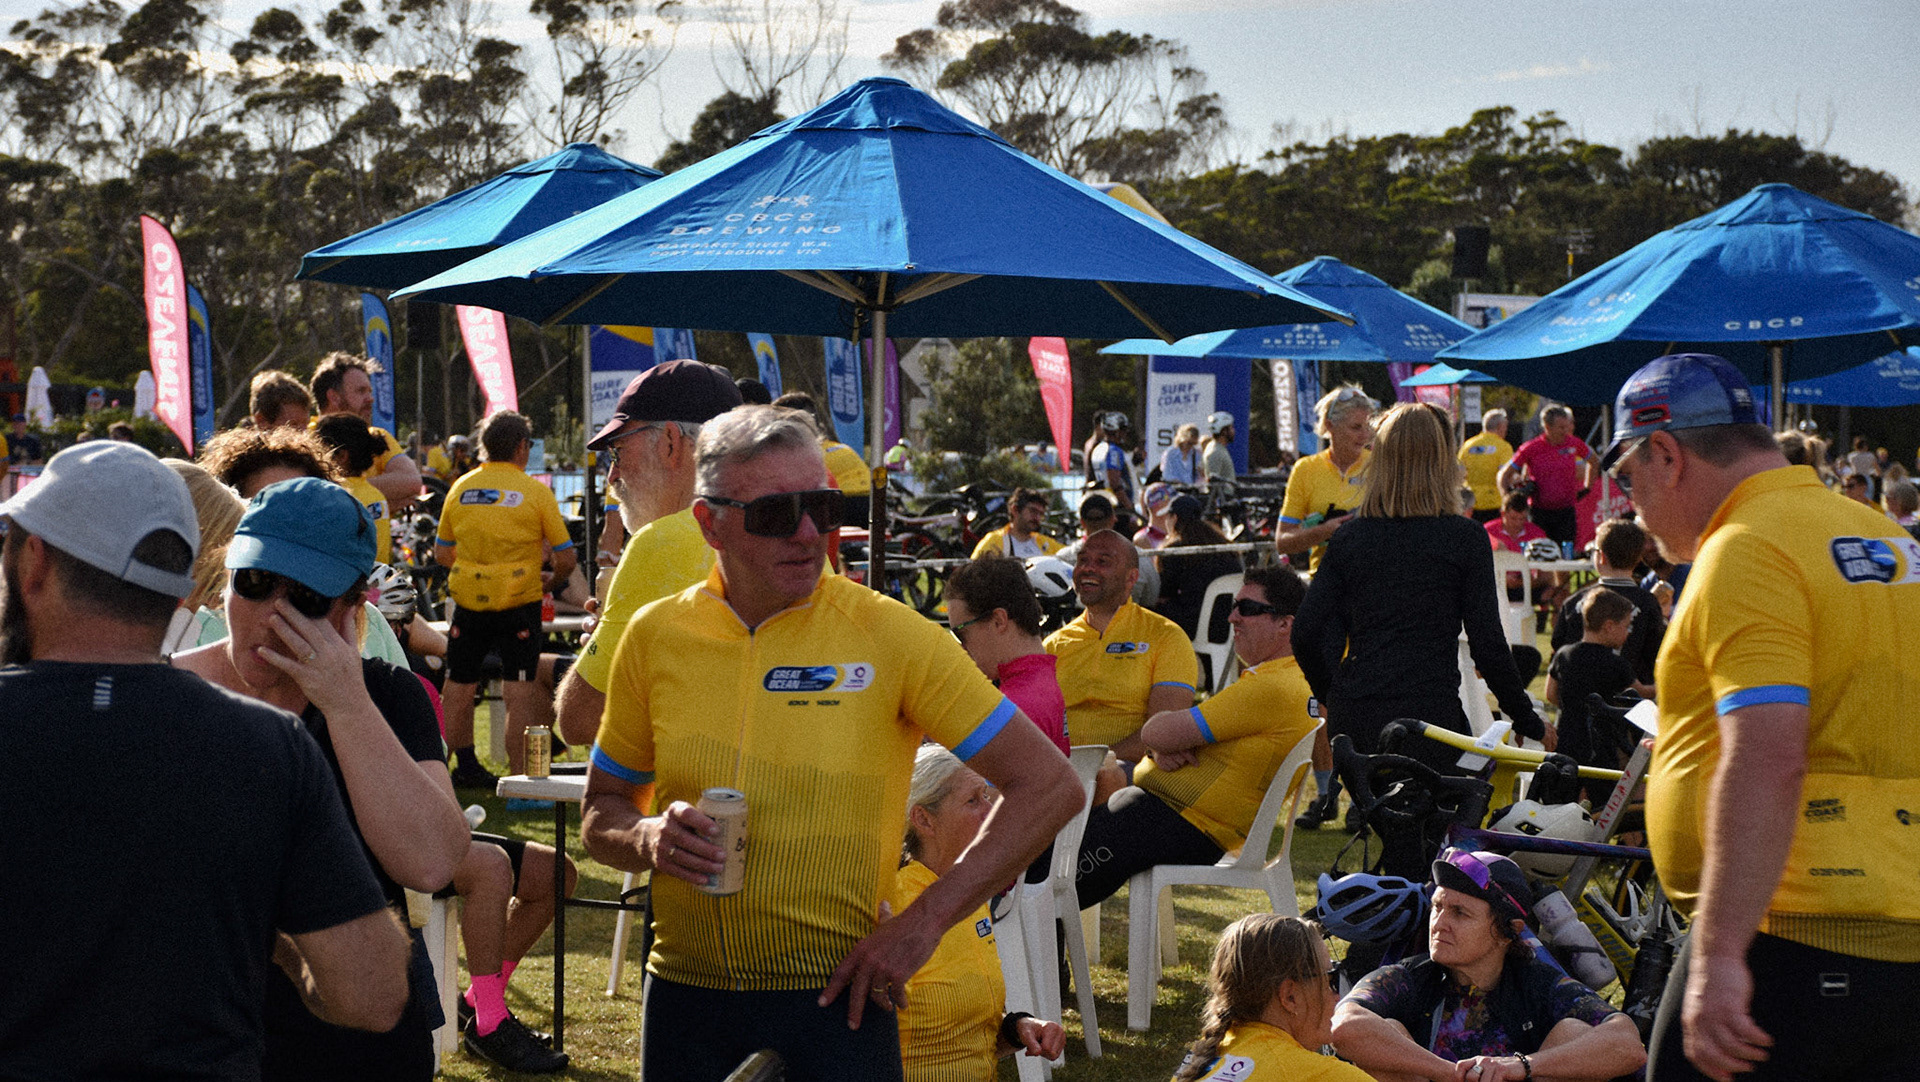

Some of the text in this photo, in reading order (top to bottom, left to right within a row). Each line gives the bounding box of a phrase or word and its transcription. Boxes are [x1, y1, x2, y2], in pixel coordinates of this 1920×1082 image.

[670, 225, 842, 236] BREWING
[656, 241, 740, 249] MARGARET
[1262, 338, 1341, 346] BREWING
[1161, 382, 1198, 395] SURF
[1157, 393, 1200, 407] COAST
[772, 669, 803, 680] GREAT
[768, 679, 801, 690] OCEAN
